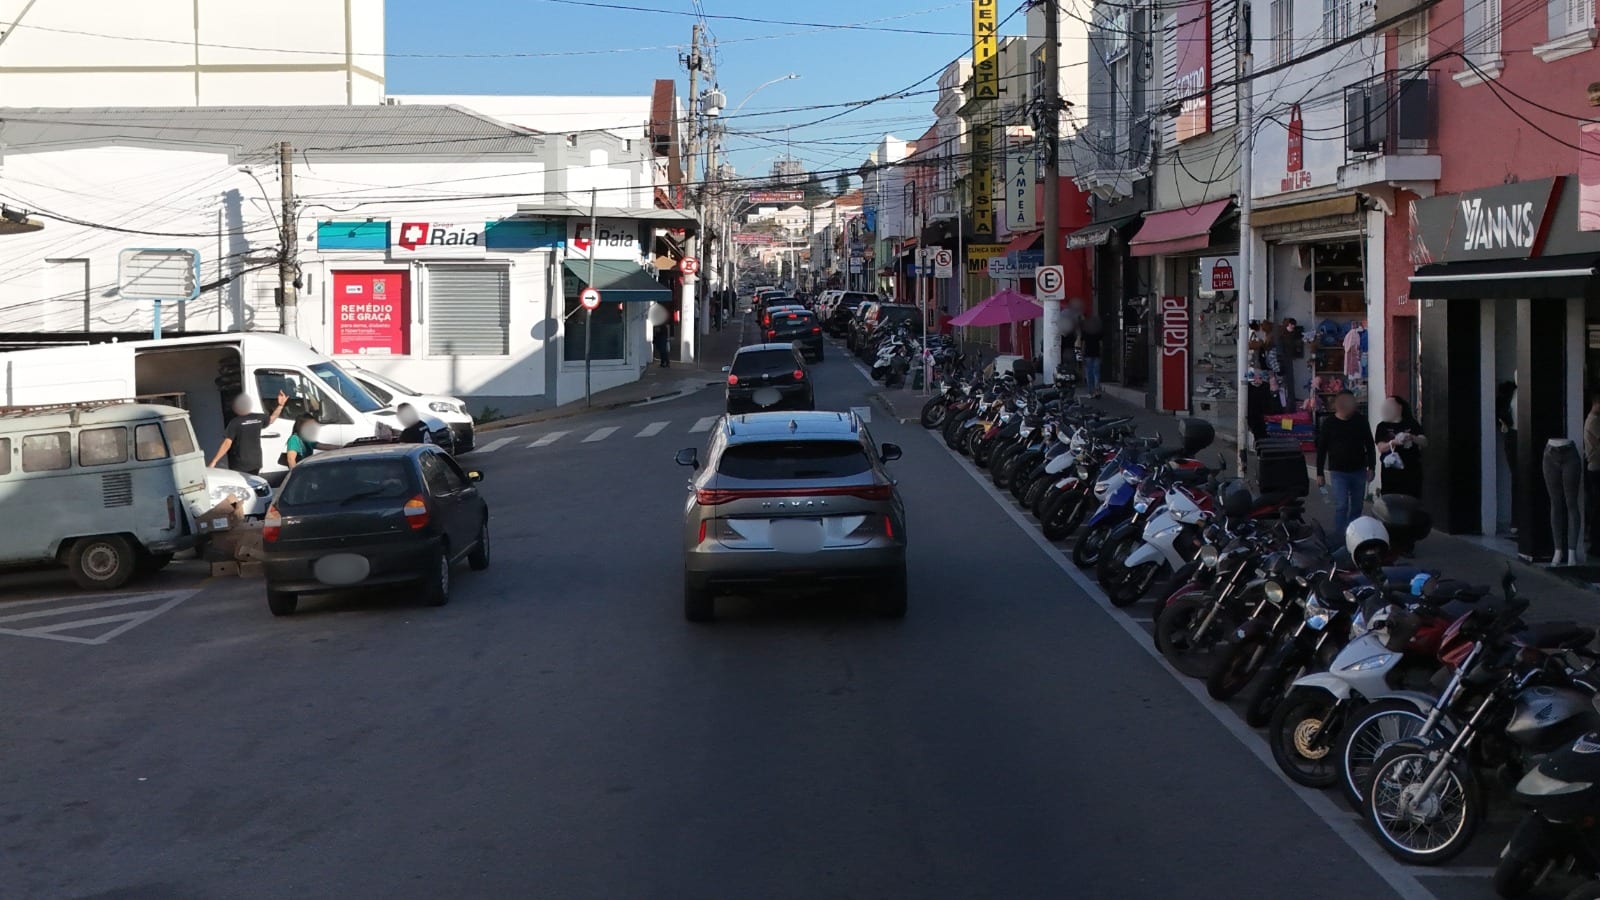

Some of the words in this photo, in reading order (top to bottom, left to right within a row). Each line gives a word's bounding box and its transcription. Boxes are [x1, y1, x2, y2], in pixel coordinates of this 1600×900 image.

[978, 0, 993, 95] DENTISTA
[975, 127, 990, 232] DENTISTA
[1016, 155, 1026, 222] CAMPEÃ
[430, 228, 478, 246] Raia
[598, 229, 634, 247] Raia
[1462, 198, 1535, 250] YANNIS
[1044, 272, 1055, 288] E
[341, 302, 393, 313] REMÉDIO
[341, 313, 355, 321] DE
[357, 313, 391, 323] GRAÇA
[1164, 296, 1188, 356] scarpe
